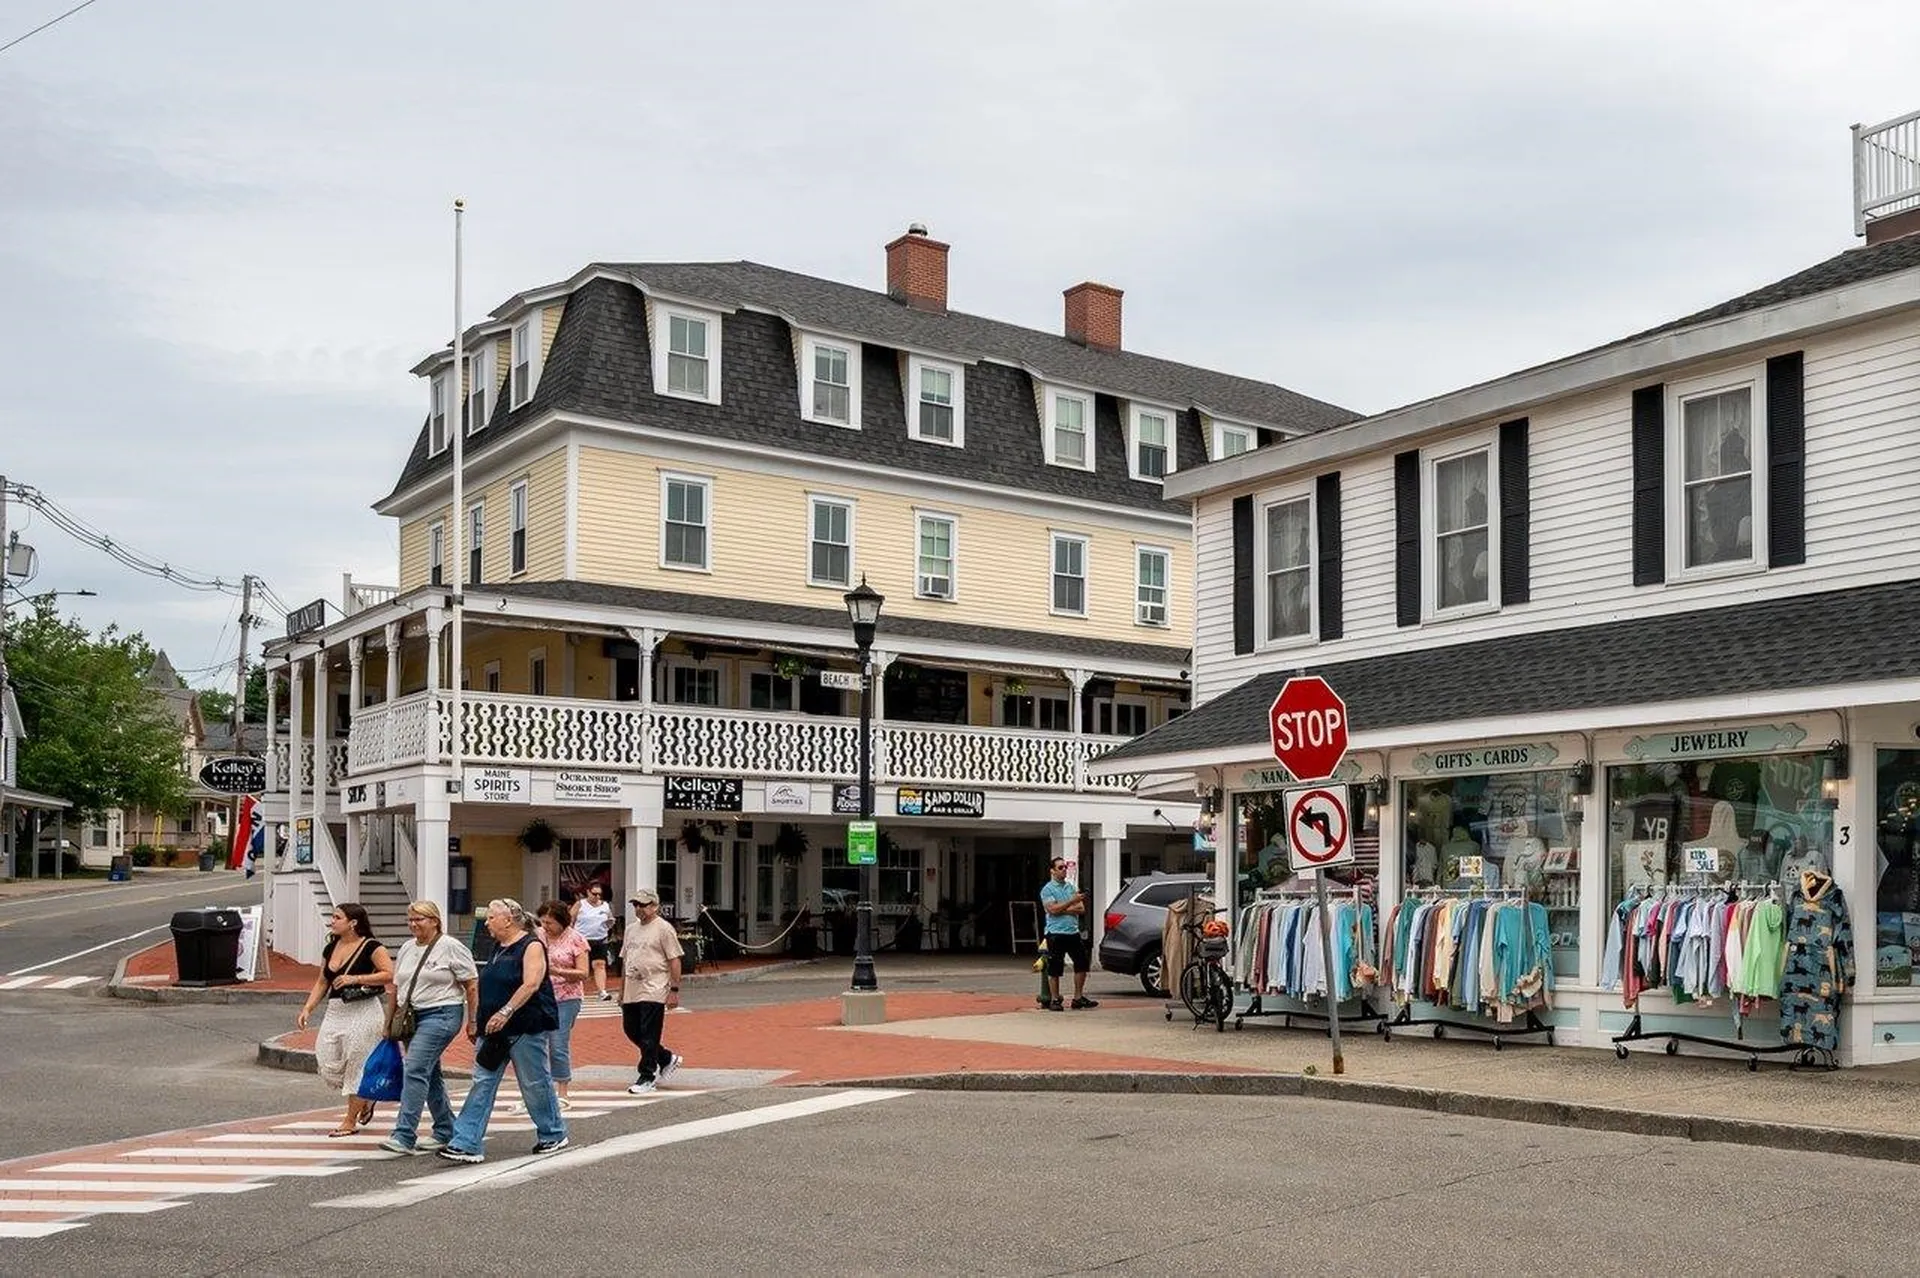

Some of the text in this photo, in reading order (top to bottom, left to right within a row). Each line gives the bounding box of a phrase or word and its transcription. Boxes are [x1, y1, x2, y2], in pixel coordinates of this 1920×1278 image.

[823, 673, 850, 685] BEACH
[1278, 709, 1341, 751] STOP
[1670, 731, 1748, 753] JEWELRY
[1435, 748, 1528, 769] GIFTS CARDS
[212, 762, 264, 776] Kelley's
[484, 770, 511, 778] MAINE
[474, 778, 521, 792] SPIRITS
[668, 777, 736, 794] Kelley's
[484, 792, 511, 801] STORE
[924, 791, 983, 814] SAND DOLLAR
[1840, 826, 1850, 845] 3
